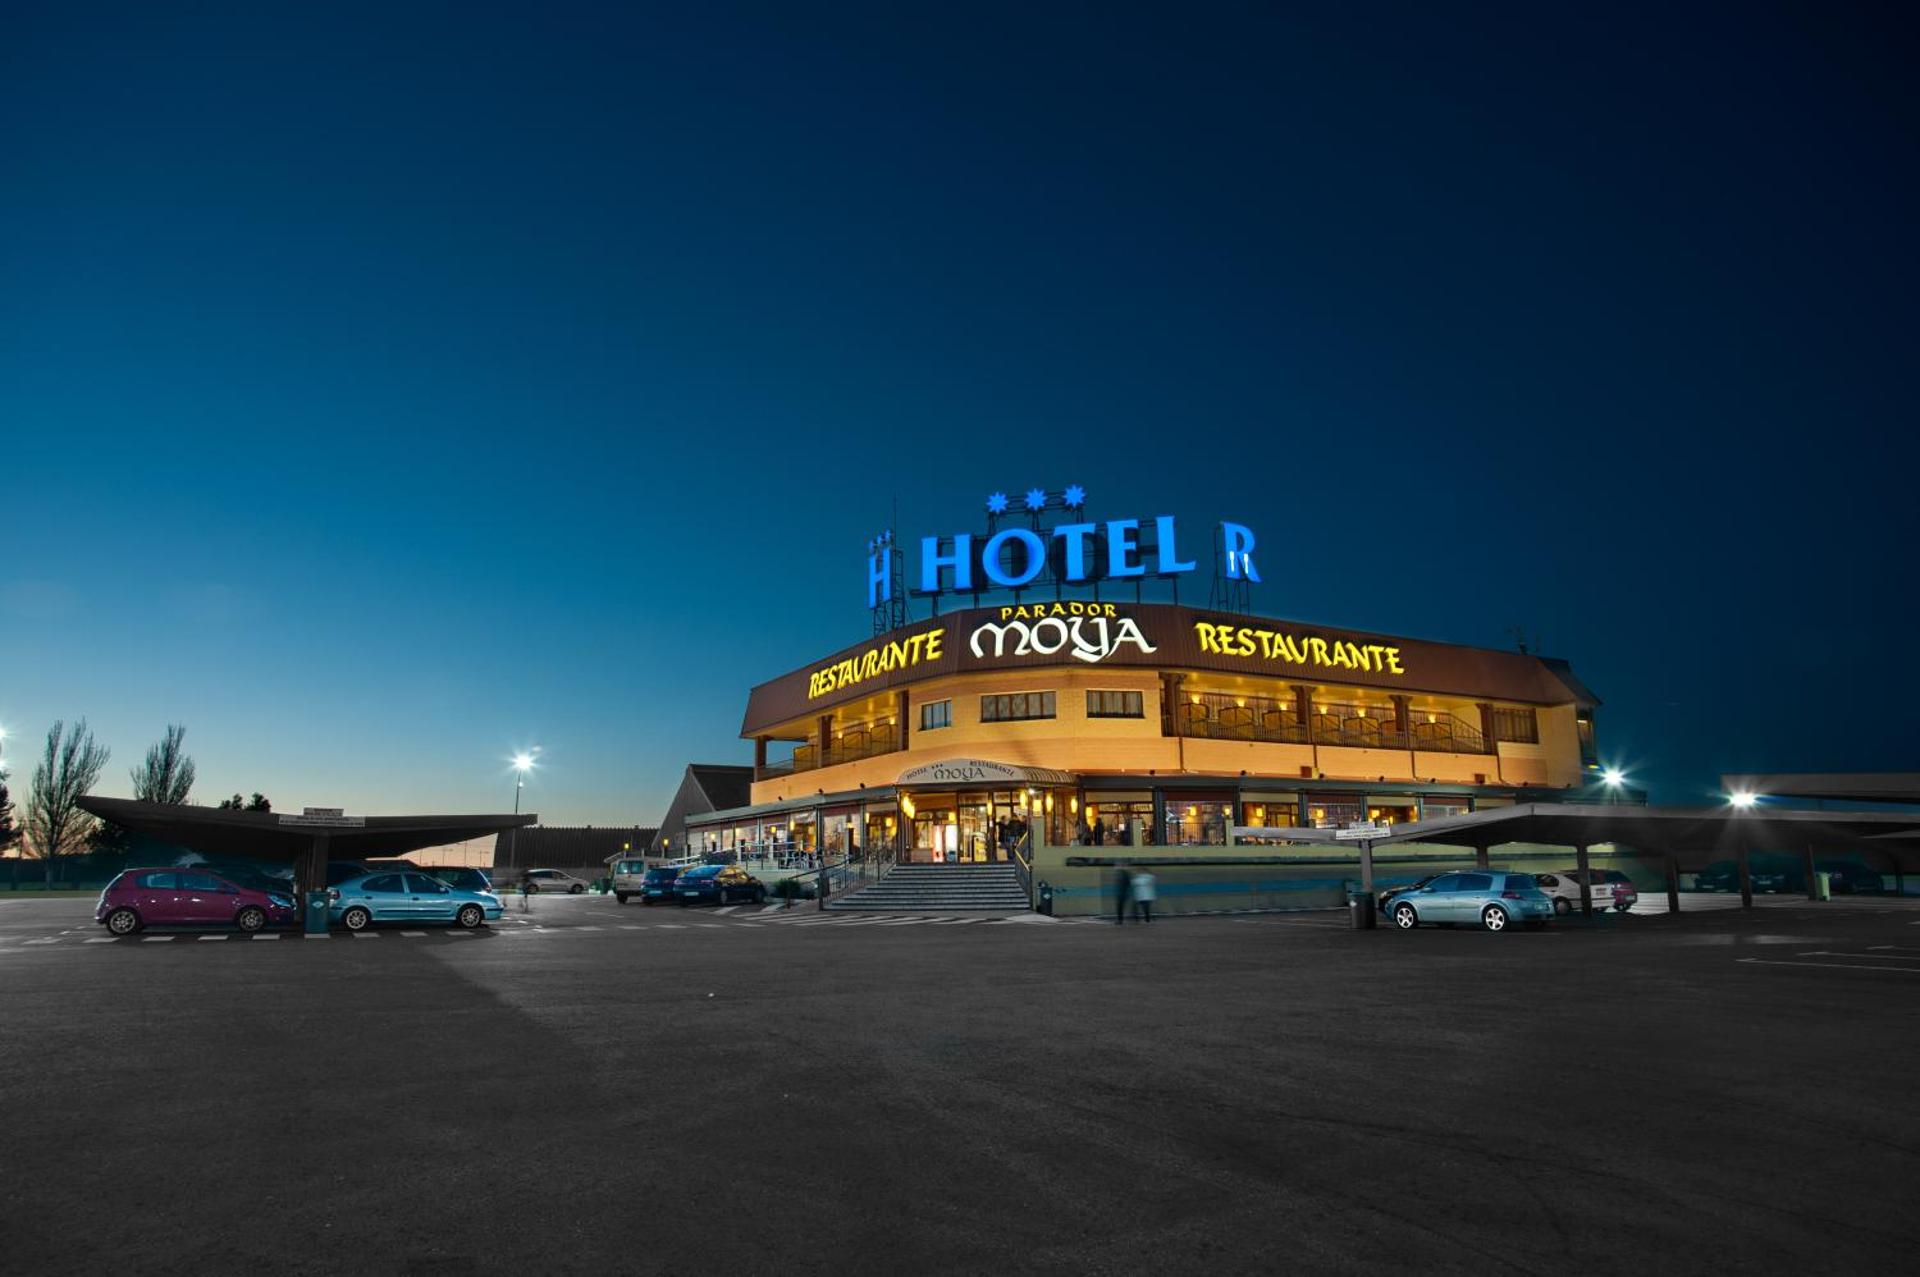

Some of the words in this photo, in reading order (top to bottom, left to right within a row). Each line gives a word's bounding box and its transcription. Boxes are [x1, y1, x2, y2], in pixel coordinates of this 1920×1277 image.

[868, 546, 892, 609] H
[921, 515, 1196, 592] HOTEL
[1221, 520, 1261, 583] R
[970, 616, 1157, 663] MOYA
[1001, 602, 1117, 620] PARADOR
[808, 628, 946, 699] RESTAURANTE
[1194, 622, 1405, 674] RESTAURANTE
[933, 767, 985, 782] MOYA
